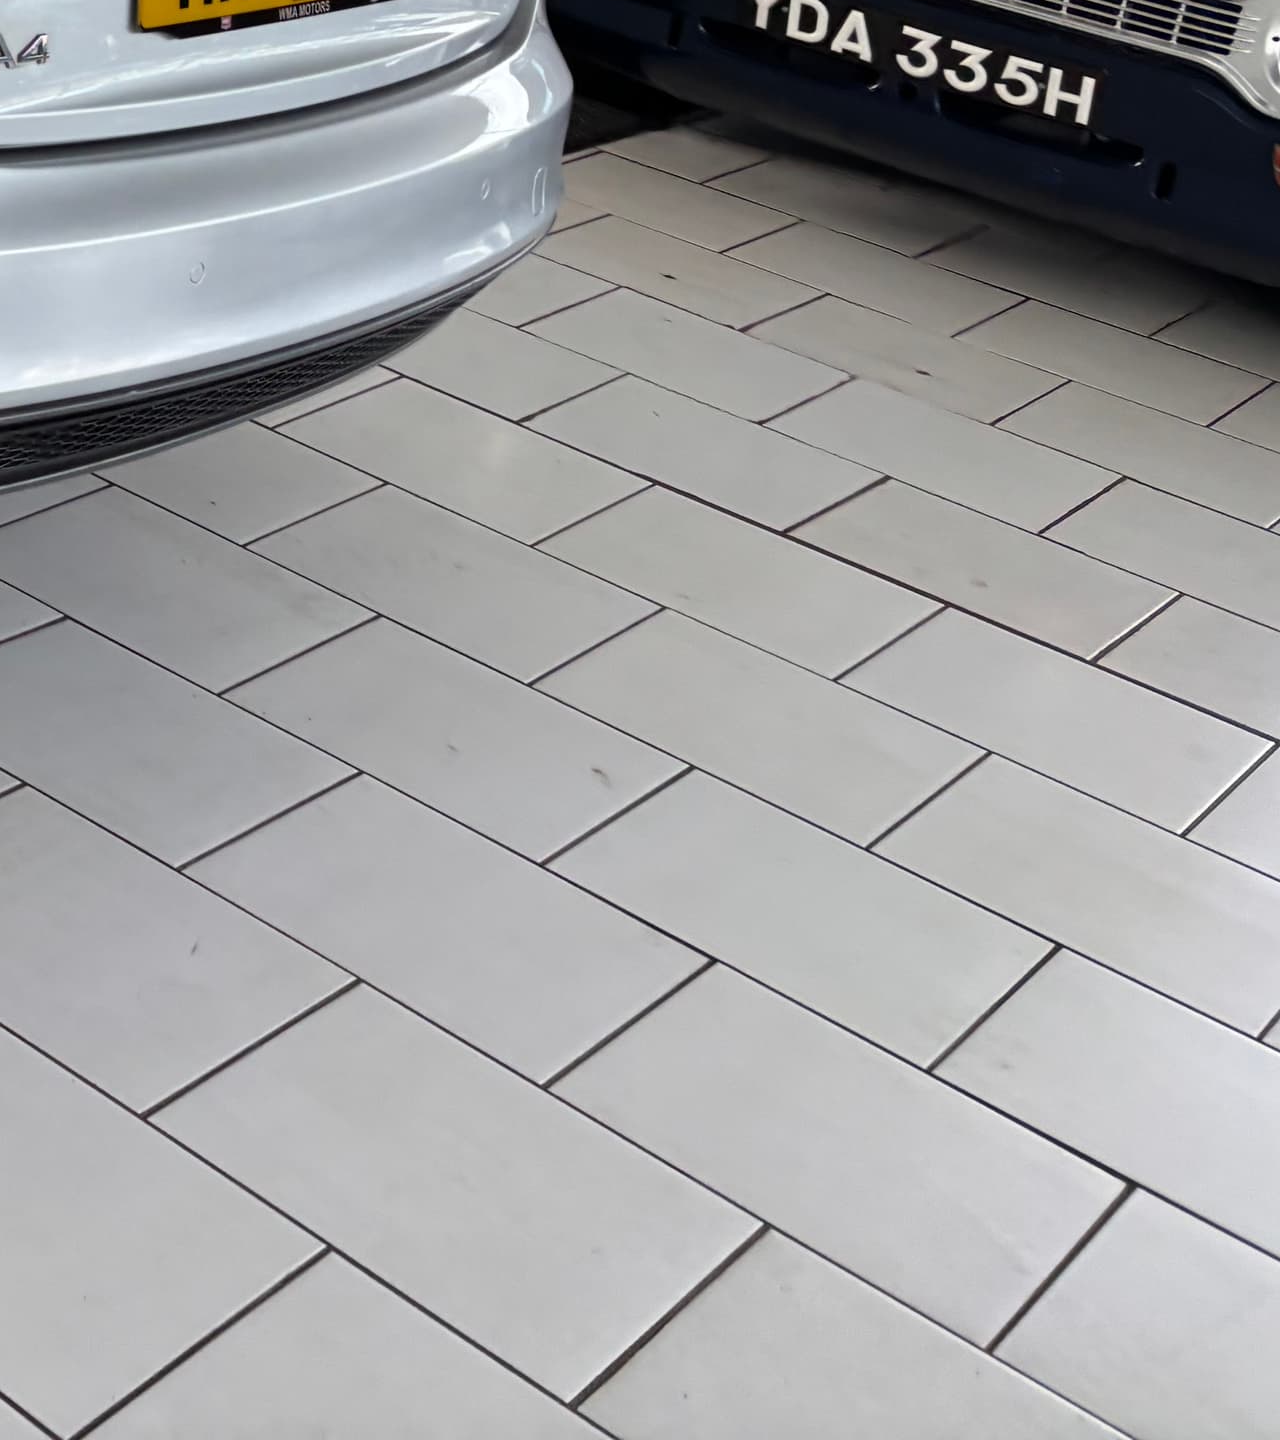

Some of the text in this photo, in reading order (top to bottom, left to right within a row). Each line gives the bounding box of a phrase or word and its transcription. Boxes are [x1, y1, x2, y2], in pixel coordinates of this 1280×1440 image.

[278, 0, 331, 21] WMA MOTORS
[895, 25, 1099, 127] 335H
